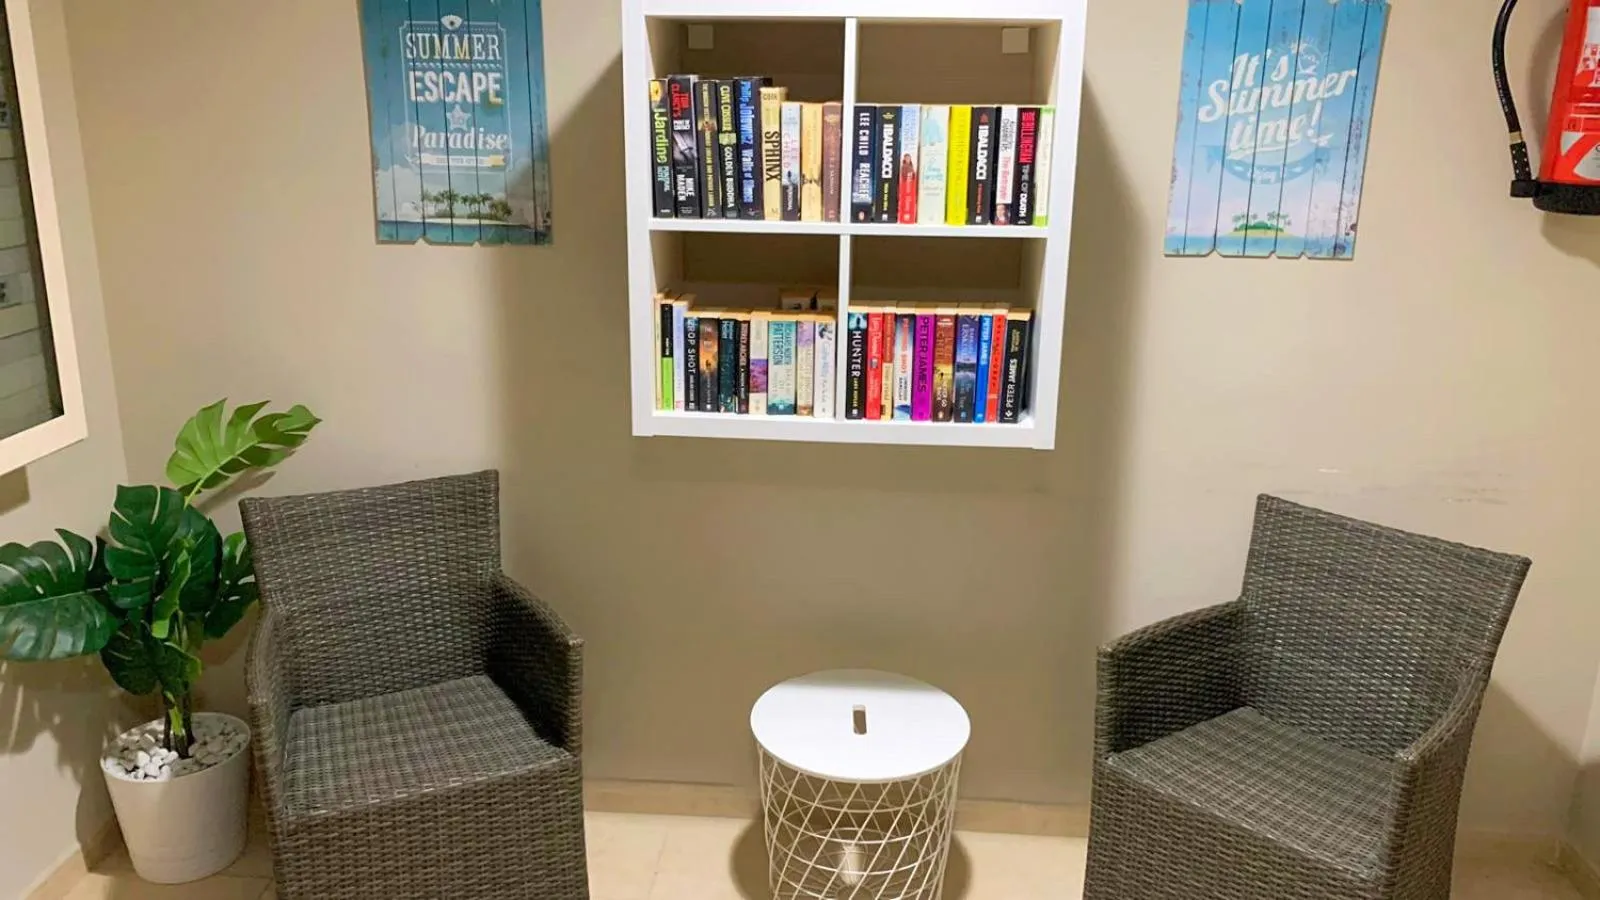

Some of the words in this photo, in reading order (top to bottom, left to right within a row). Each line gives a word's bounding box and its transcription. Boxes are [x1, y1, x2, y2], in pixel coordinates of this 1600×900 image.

[406, 32, 502, 60] SUMMER
[1230, 48, 1290, 88] It's
[408, 70, 503, 104] ESCAPE
[720, 86, 730, 104] CLIVE
[1198, 69, 1357, 123] Summer
[859, 112, 870, 126] LEE
[1228, 100, 1322, 151] time!
[412, 126, 508, 149] Paradise
[655, 113, 668, 163] Jardine
[859, 130, 869, 156] CHILD
[1019, 122, 1035, 163] BILLINGHAM
[724, 147, 733, 175] GOLDEN
[742, 149, 753, 171] Walls
[765, 132, 780, 182] SPHINX
[677, 174, 685, 201] MADEN
[686, 178, 694, 197] MIKE
[859, 163, 871, 199] REACHER
[1022, 183, 1029, 192] OF
[1019, 193, 1028, 217] DEATH
[687, 320, 696, 345] DROP
[919, 317, 929, 353] PETER
[982, 318, 990, 340] PETER
[773, 322, 783, 365] PATTERSON
[852, 331, 863, 377] HUNTER
[980, 342, 989, 365] JAMES
[918, 354, 928, 392] JAMES
[1008, 359, 1018, 383] JAMES
[1006, 384, 1015, 408] PETER
